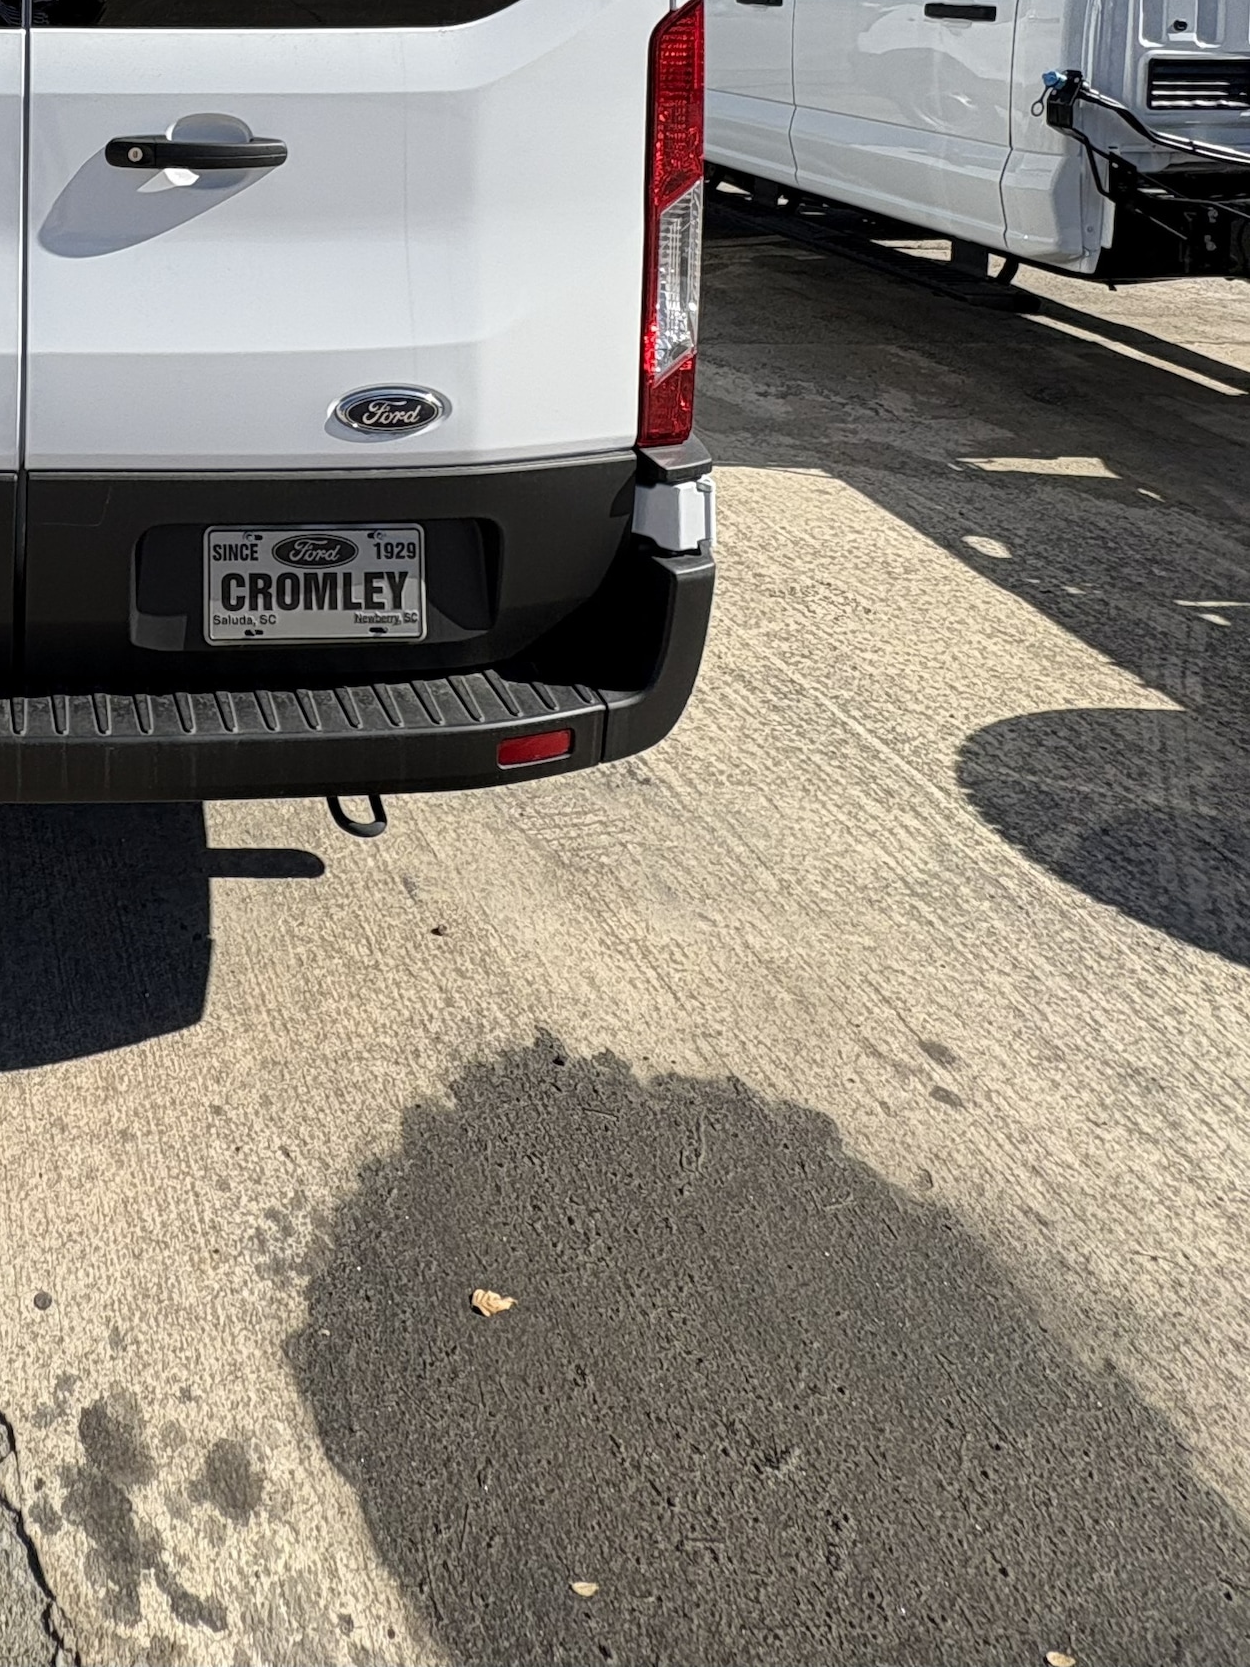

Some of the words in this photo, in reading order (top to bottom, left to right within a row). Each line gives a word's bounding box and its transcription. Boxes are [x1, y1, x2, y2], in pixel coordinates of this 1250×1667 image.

[362, 400, 421, 424] Ford
[212, 543, 259, 562] SINCE
[373, 542, 417, 560] 1929
[289, 539, 340, 561] Ford
[221, 572, 409, 611] CROMLEY
[213, 614, 256, 626] Saluda,
[260, 614, 277, 625] SC
[404, 612, 418, 623] SC
